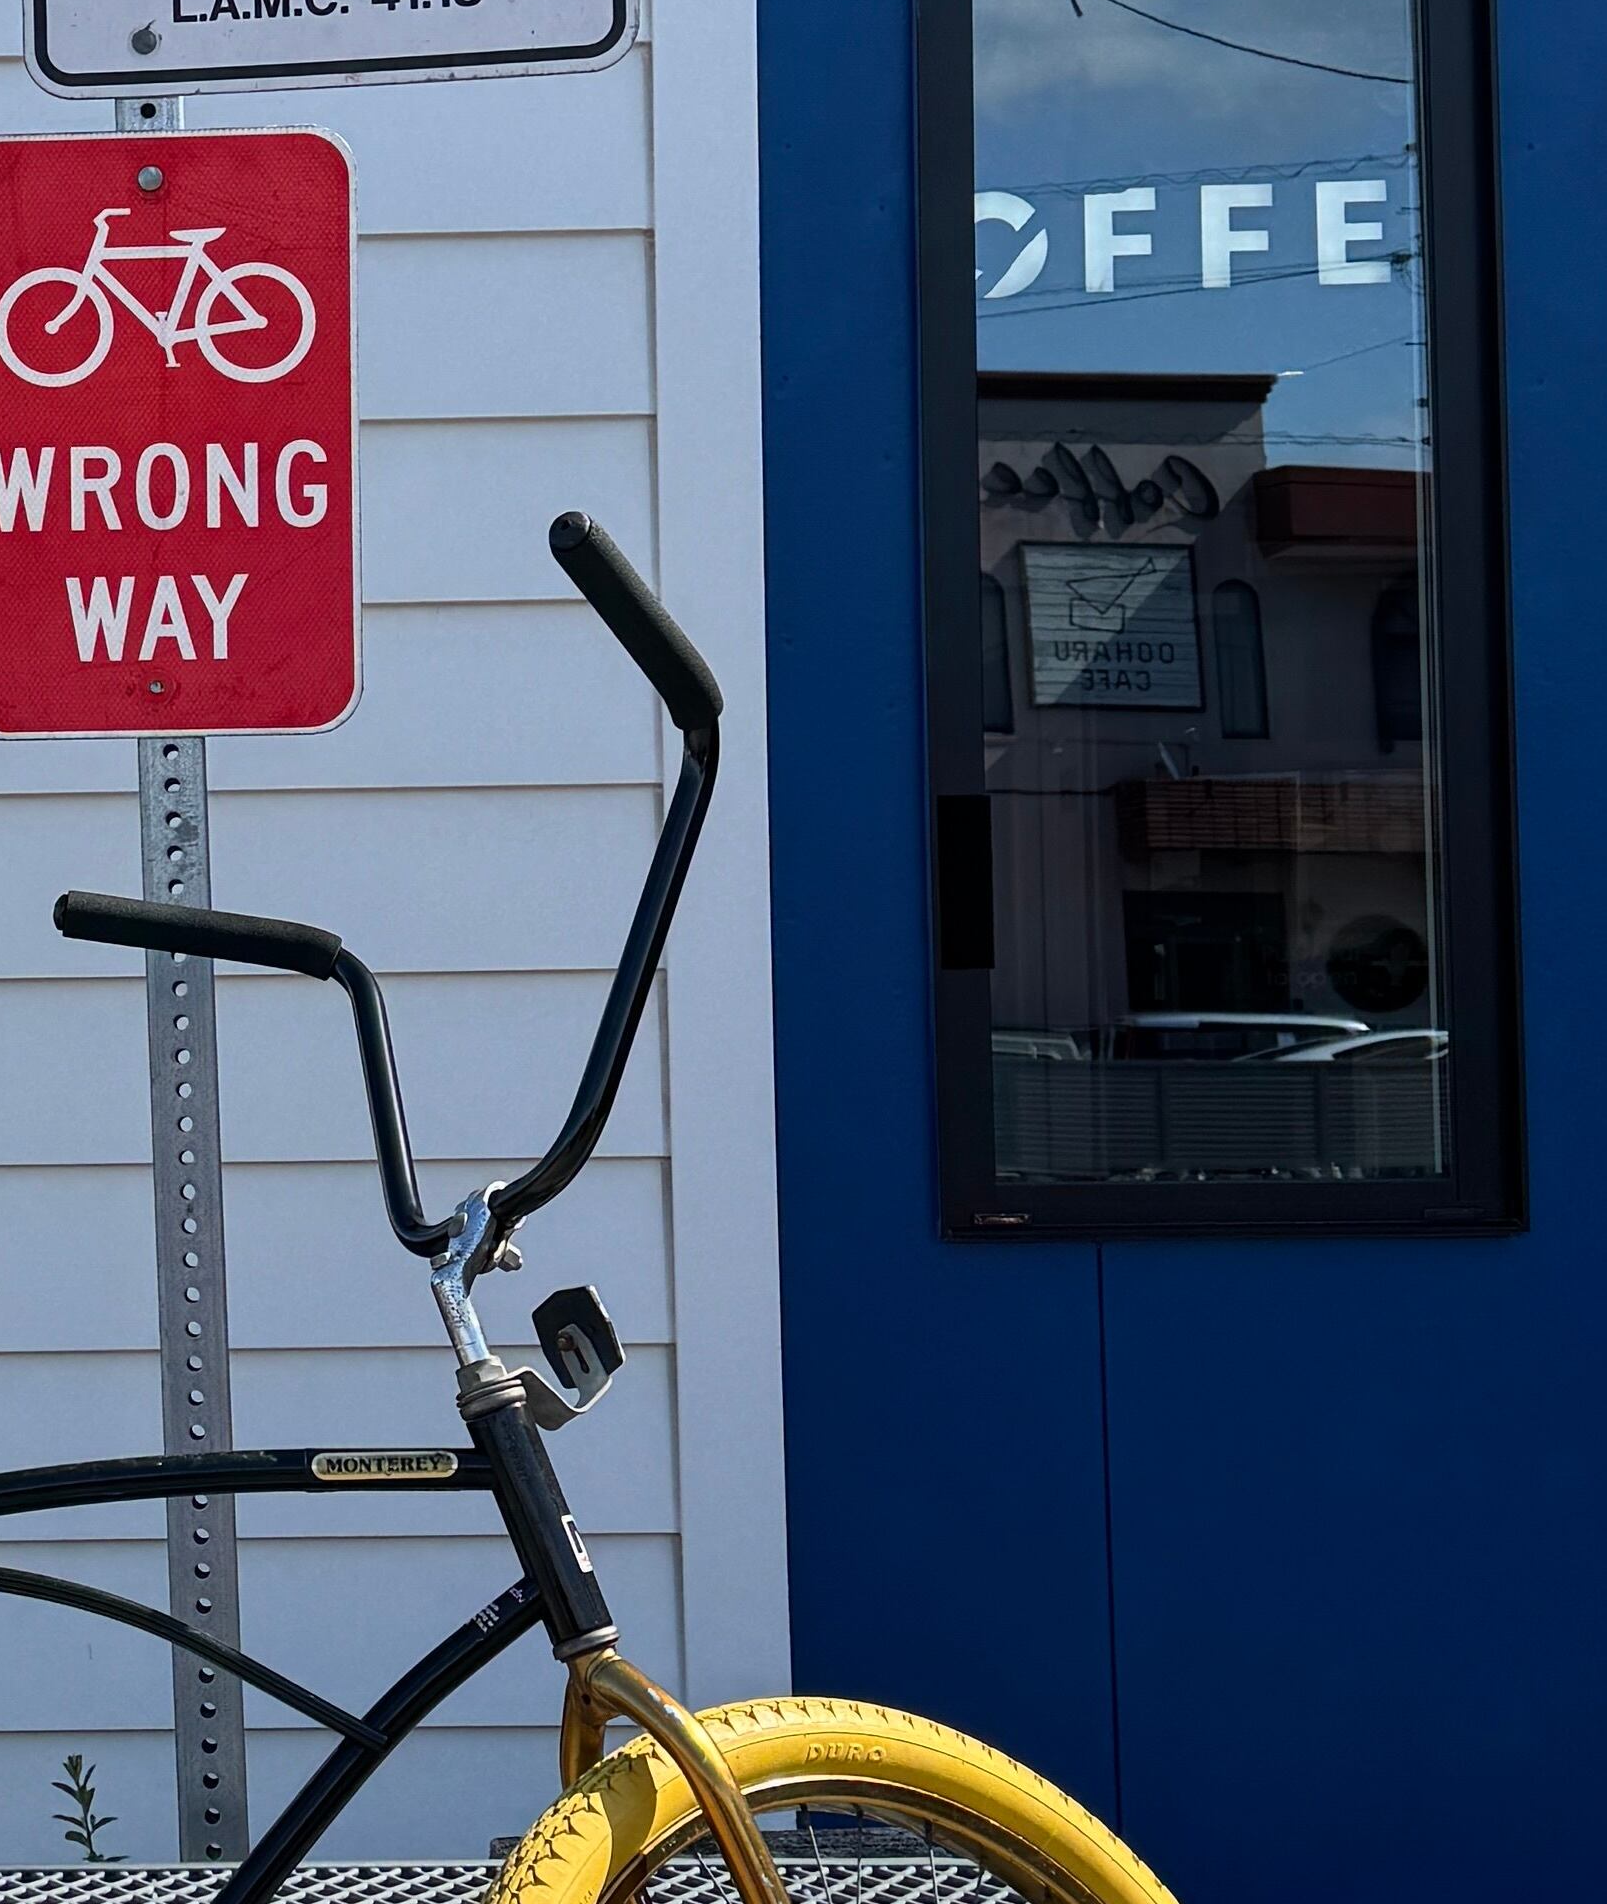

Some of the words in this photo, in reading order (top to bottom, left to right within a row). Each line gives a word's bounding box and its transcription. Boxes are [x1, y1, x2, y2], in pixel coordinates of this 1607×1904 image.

[65, 572, 250, 663] WAY
[326, 1454, 442, 1474] MONTEREY
[804, 1742, 888, 1764] DURO
